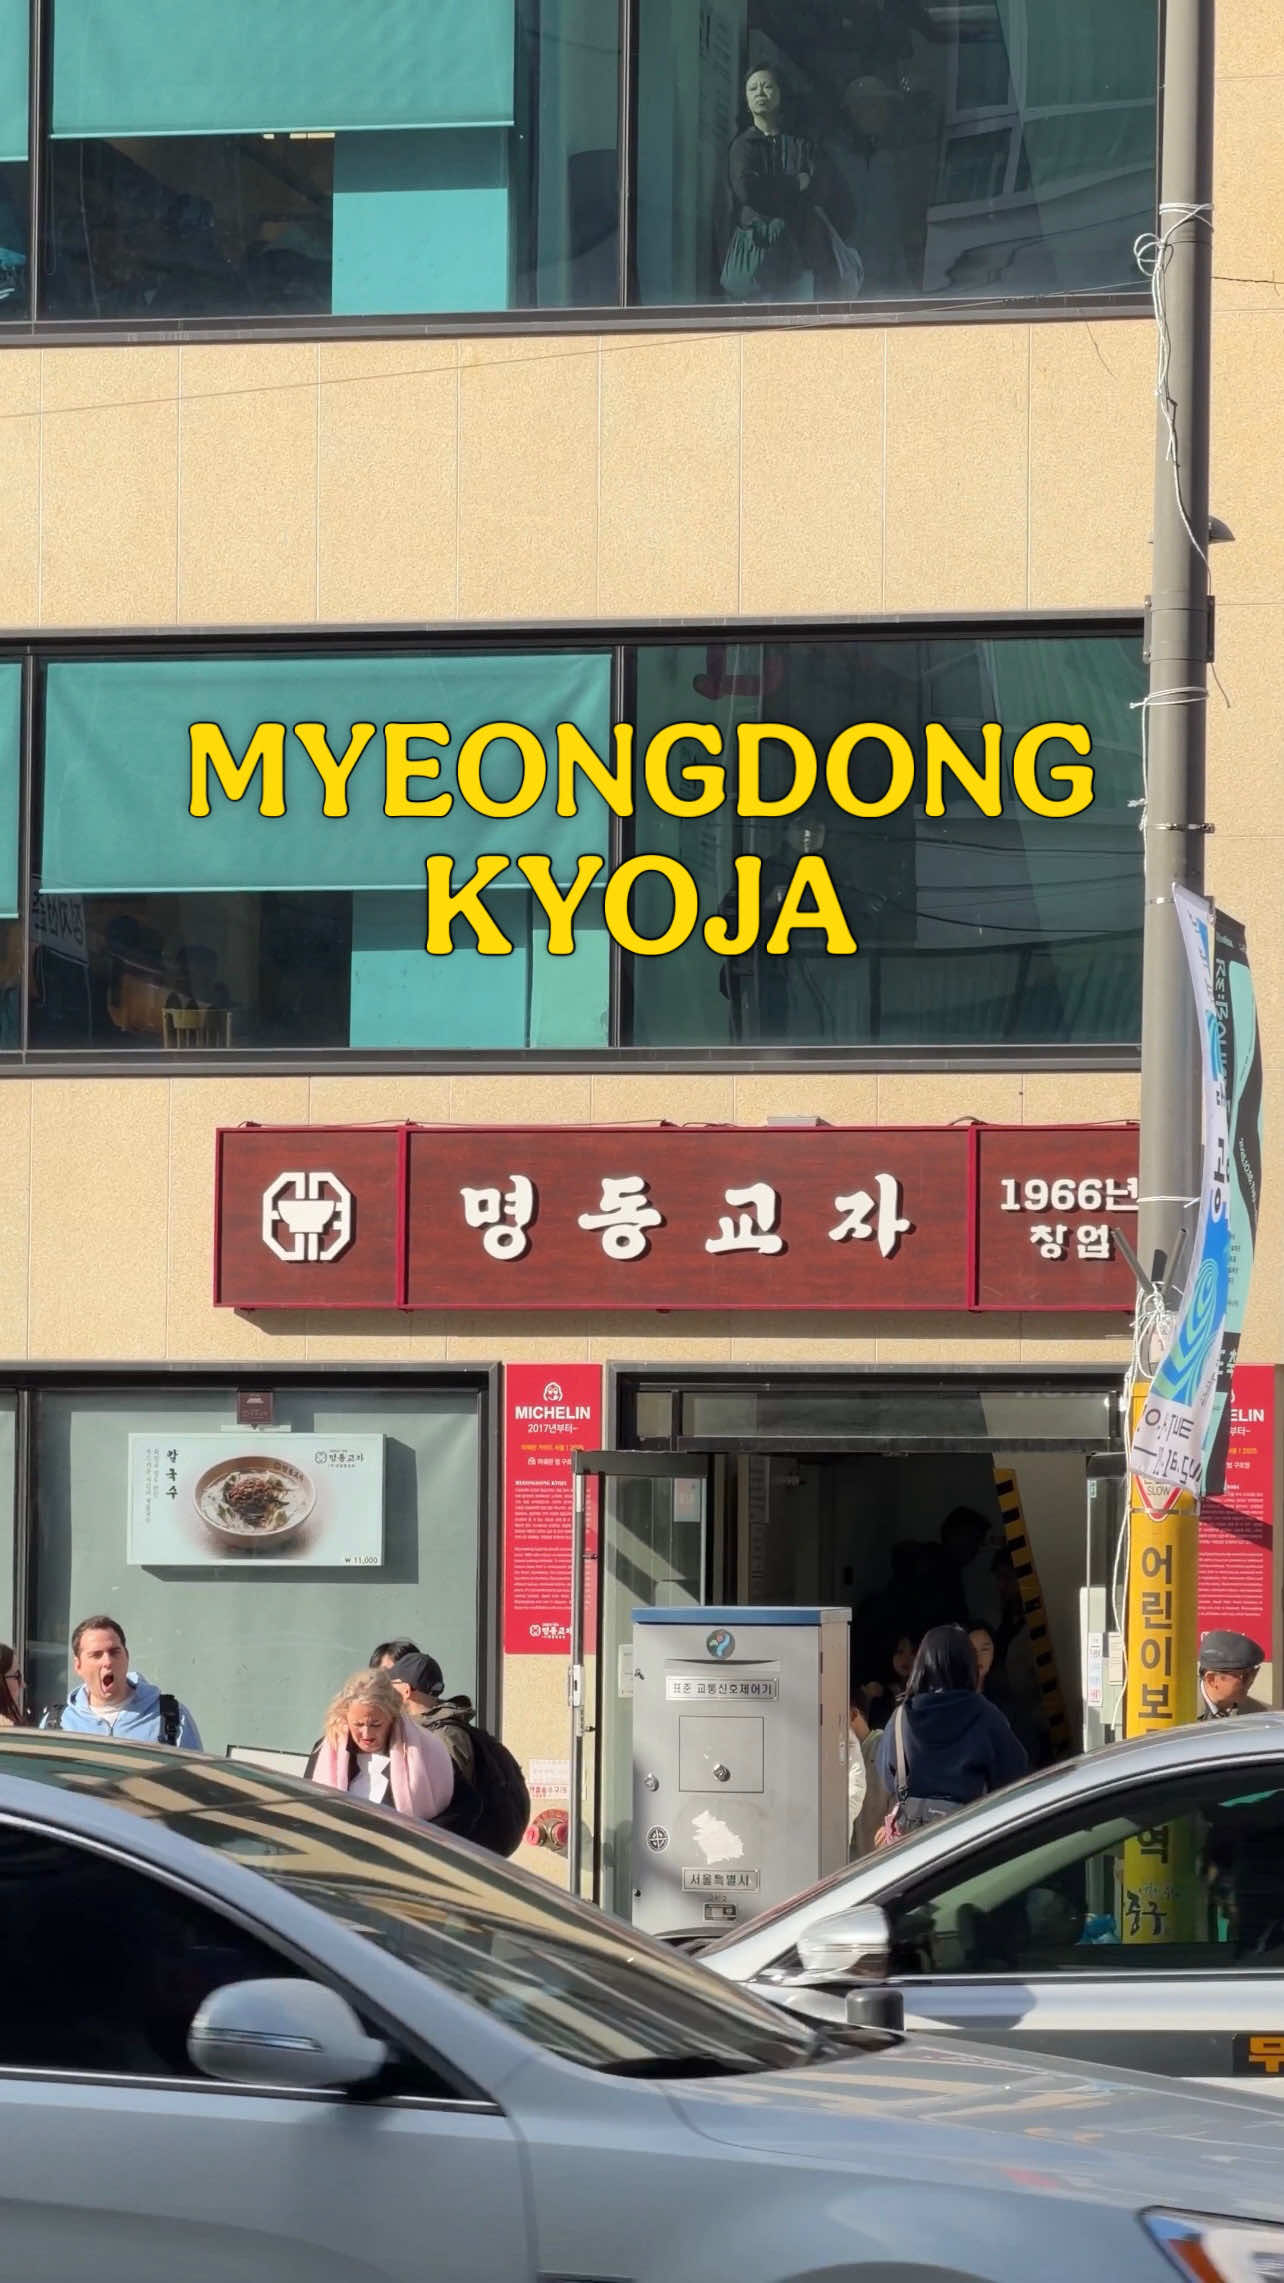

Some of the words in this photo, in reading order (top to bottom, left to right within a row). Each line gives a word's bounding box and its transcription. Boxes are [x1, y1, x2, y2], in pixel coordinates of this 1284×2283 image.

[1000, 1177, 1139, 1212] 1966년
[460, 1173, 911, 1260] 명동교자
[1029, 1224, 1110, 1260] 창업
[514, 1406, 591, 1419] MICHELIN
